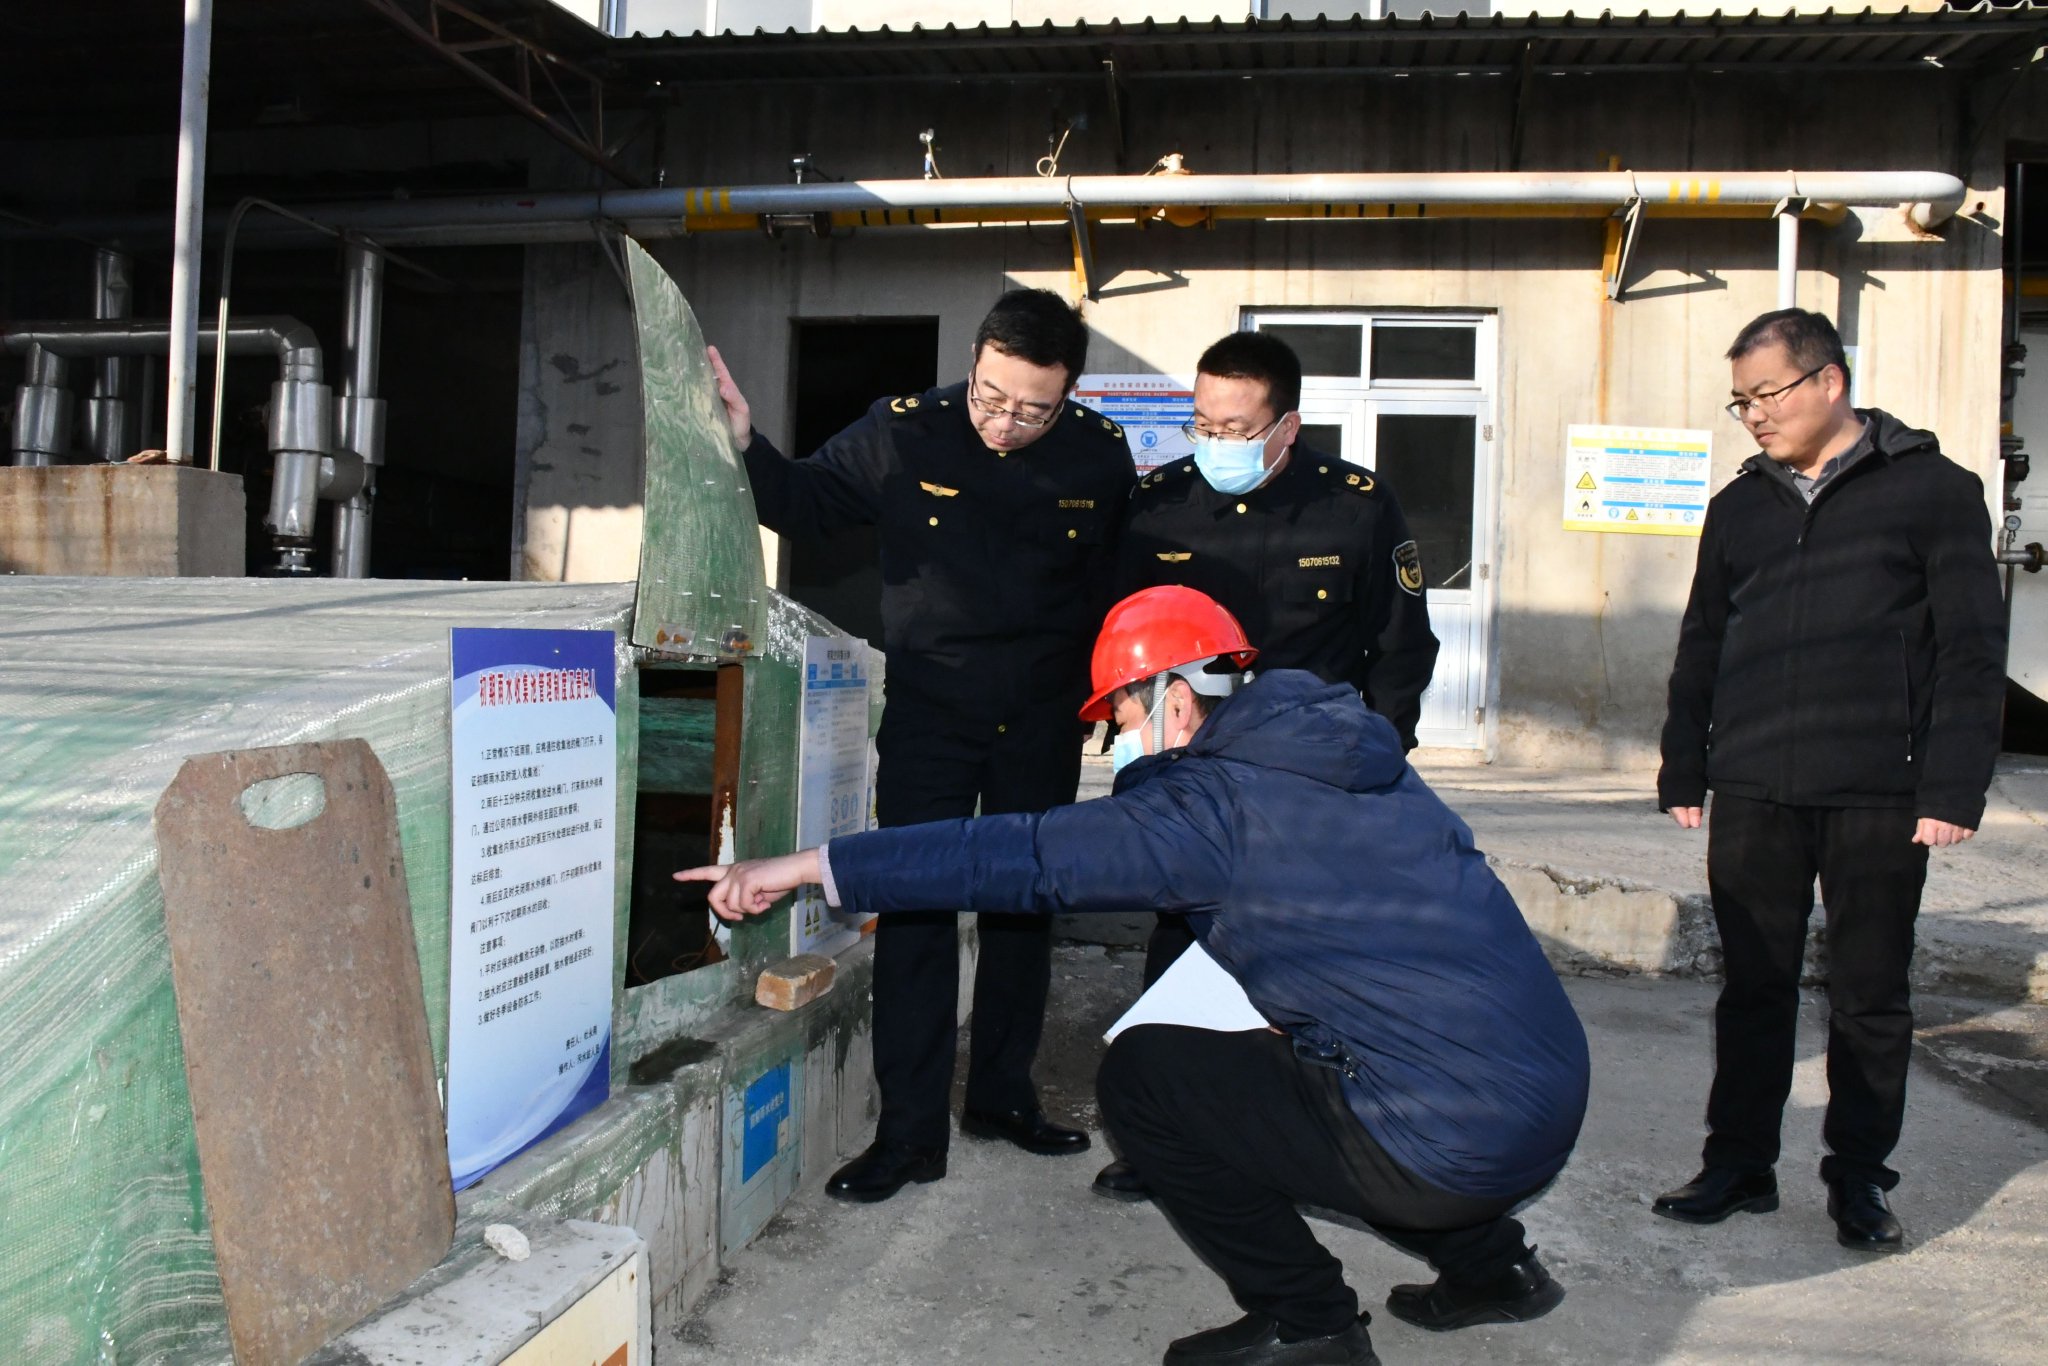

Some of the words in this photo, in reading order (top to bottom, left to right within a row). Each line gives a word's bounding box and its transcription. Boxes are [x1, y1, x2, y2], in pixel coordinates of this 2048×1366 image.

[1298, 555, 1340, 567] 15070615132
[479, 668, 597, 707] 初期雨水收集池管理制度及责任人
